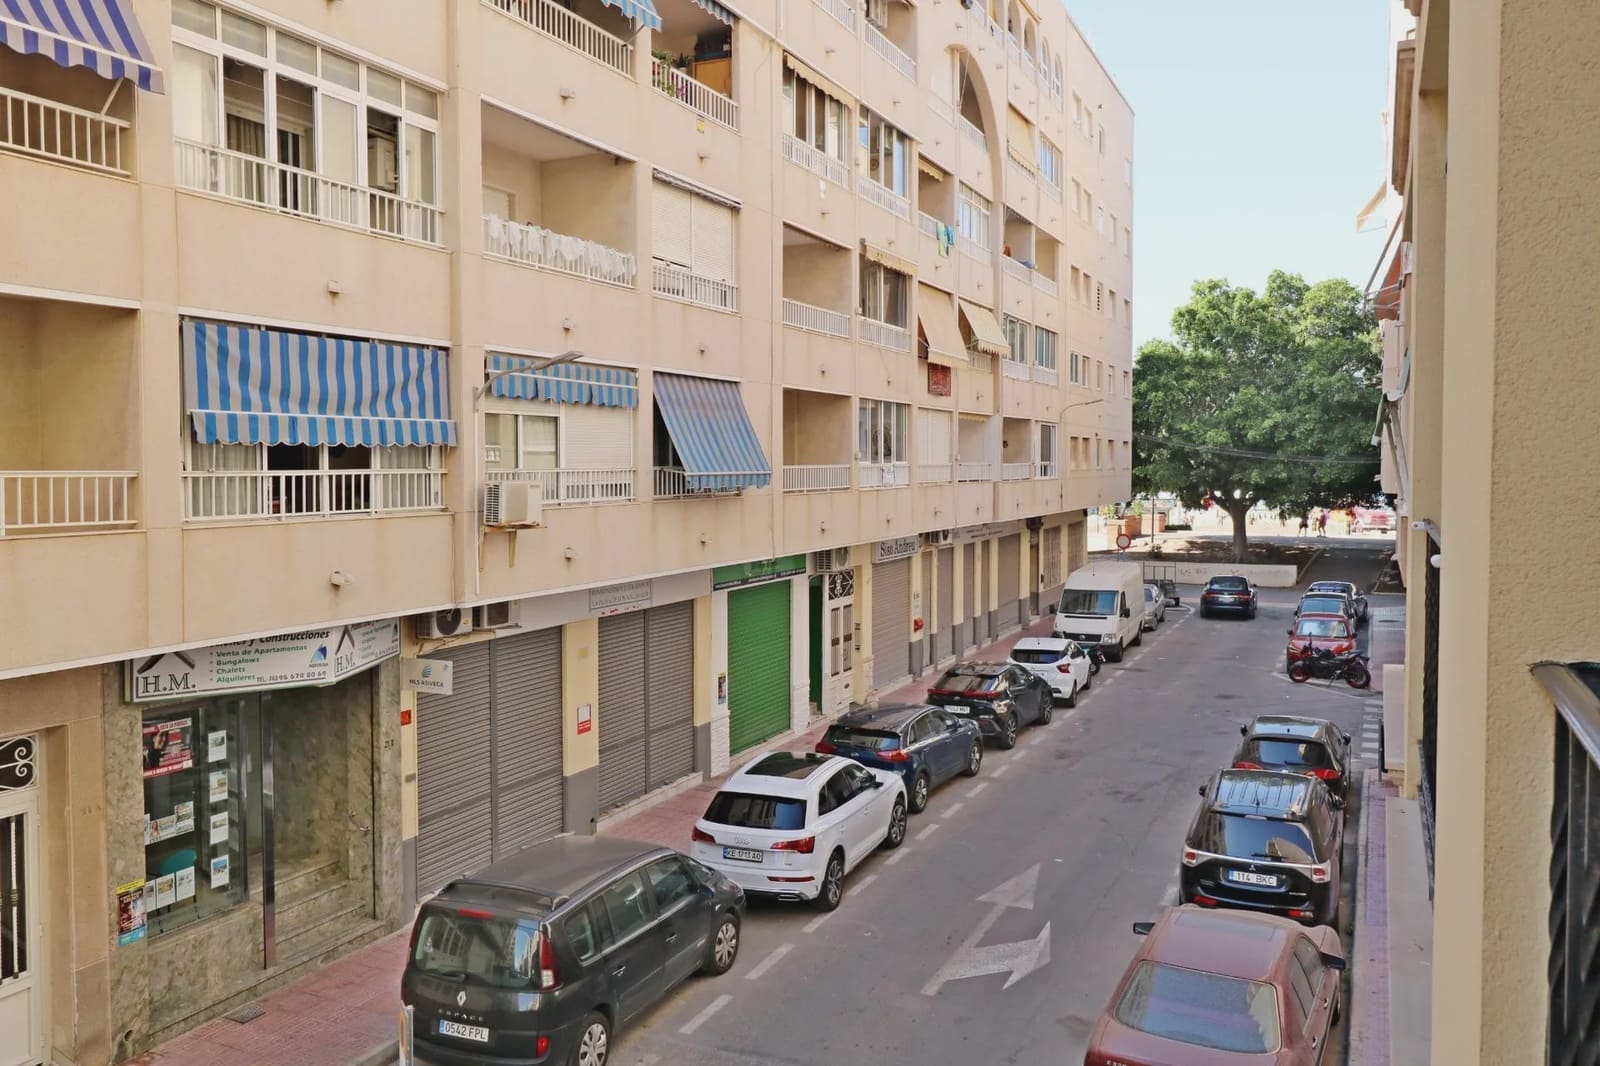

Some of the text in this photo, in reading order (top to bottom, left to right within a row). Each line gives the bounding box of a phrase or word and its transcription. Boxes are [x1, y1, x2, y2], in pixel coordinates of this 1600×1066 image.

[216, 645, 307, 658] Venta de Apartamentos
[216, 657, 260, 667] Bungalows
[216, 666, 246, 675] Chalets
[142, 672, 196, 693] H.M.
[216, 674, 256, 684] Alquileres
[1256, 875, 1274, 885] BKC
[445, 1024, 486, 1040] 0542 FPL
